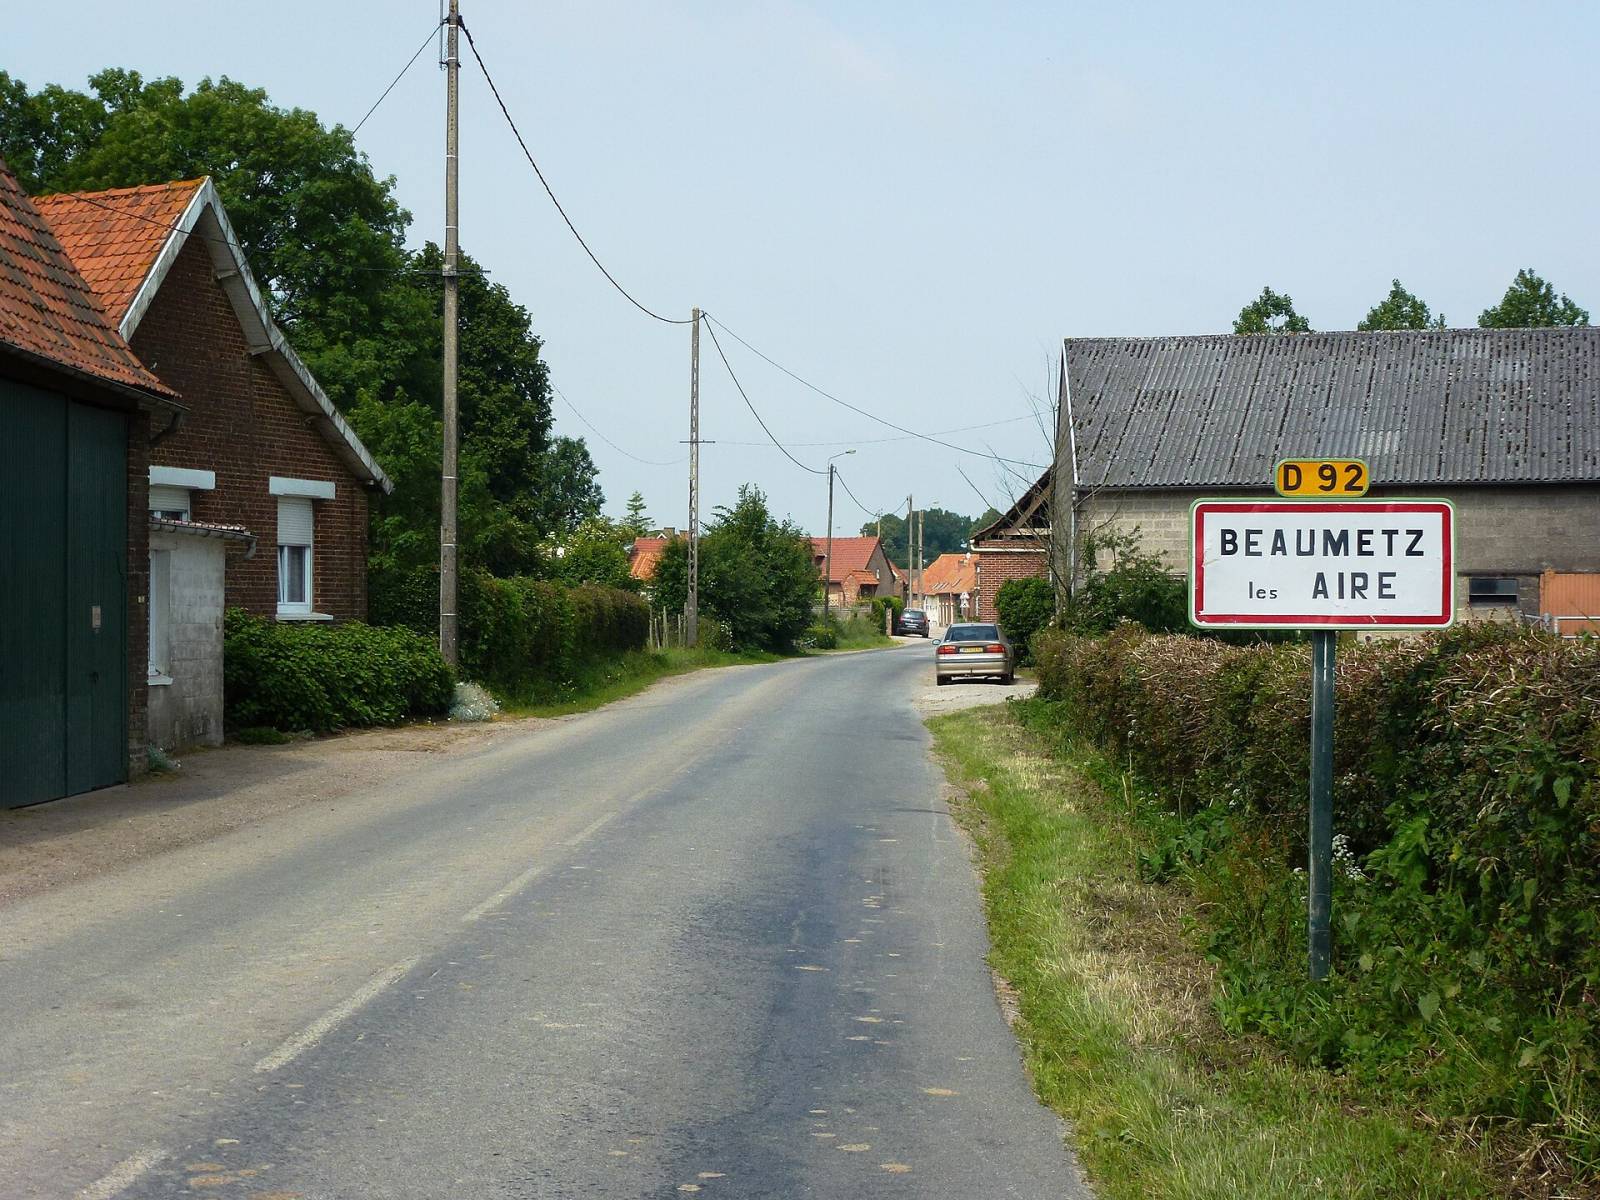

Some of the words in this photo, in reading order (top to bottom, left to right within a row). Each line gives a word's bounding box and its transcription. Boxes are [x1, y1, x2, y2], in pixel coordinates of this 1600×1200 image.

[1283, 465, 1302, 491] D
[1318, 464, 1364, 491] 92
[1220, 528, 1424, 557] BEAUMETZ
[1249, 581, 1278, 600] les
[1312, 571, 1397, 600] AIRE
